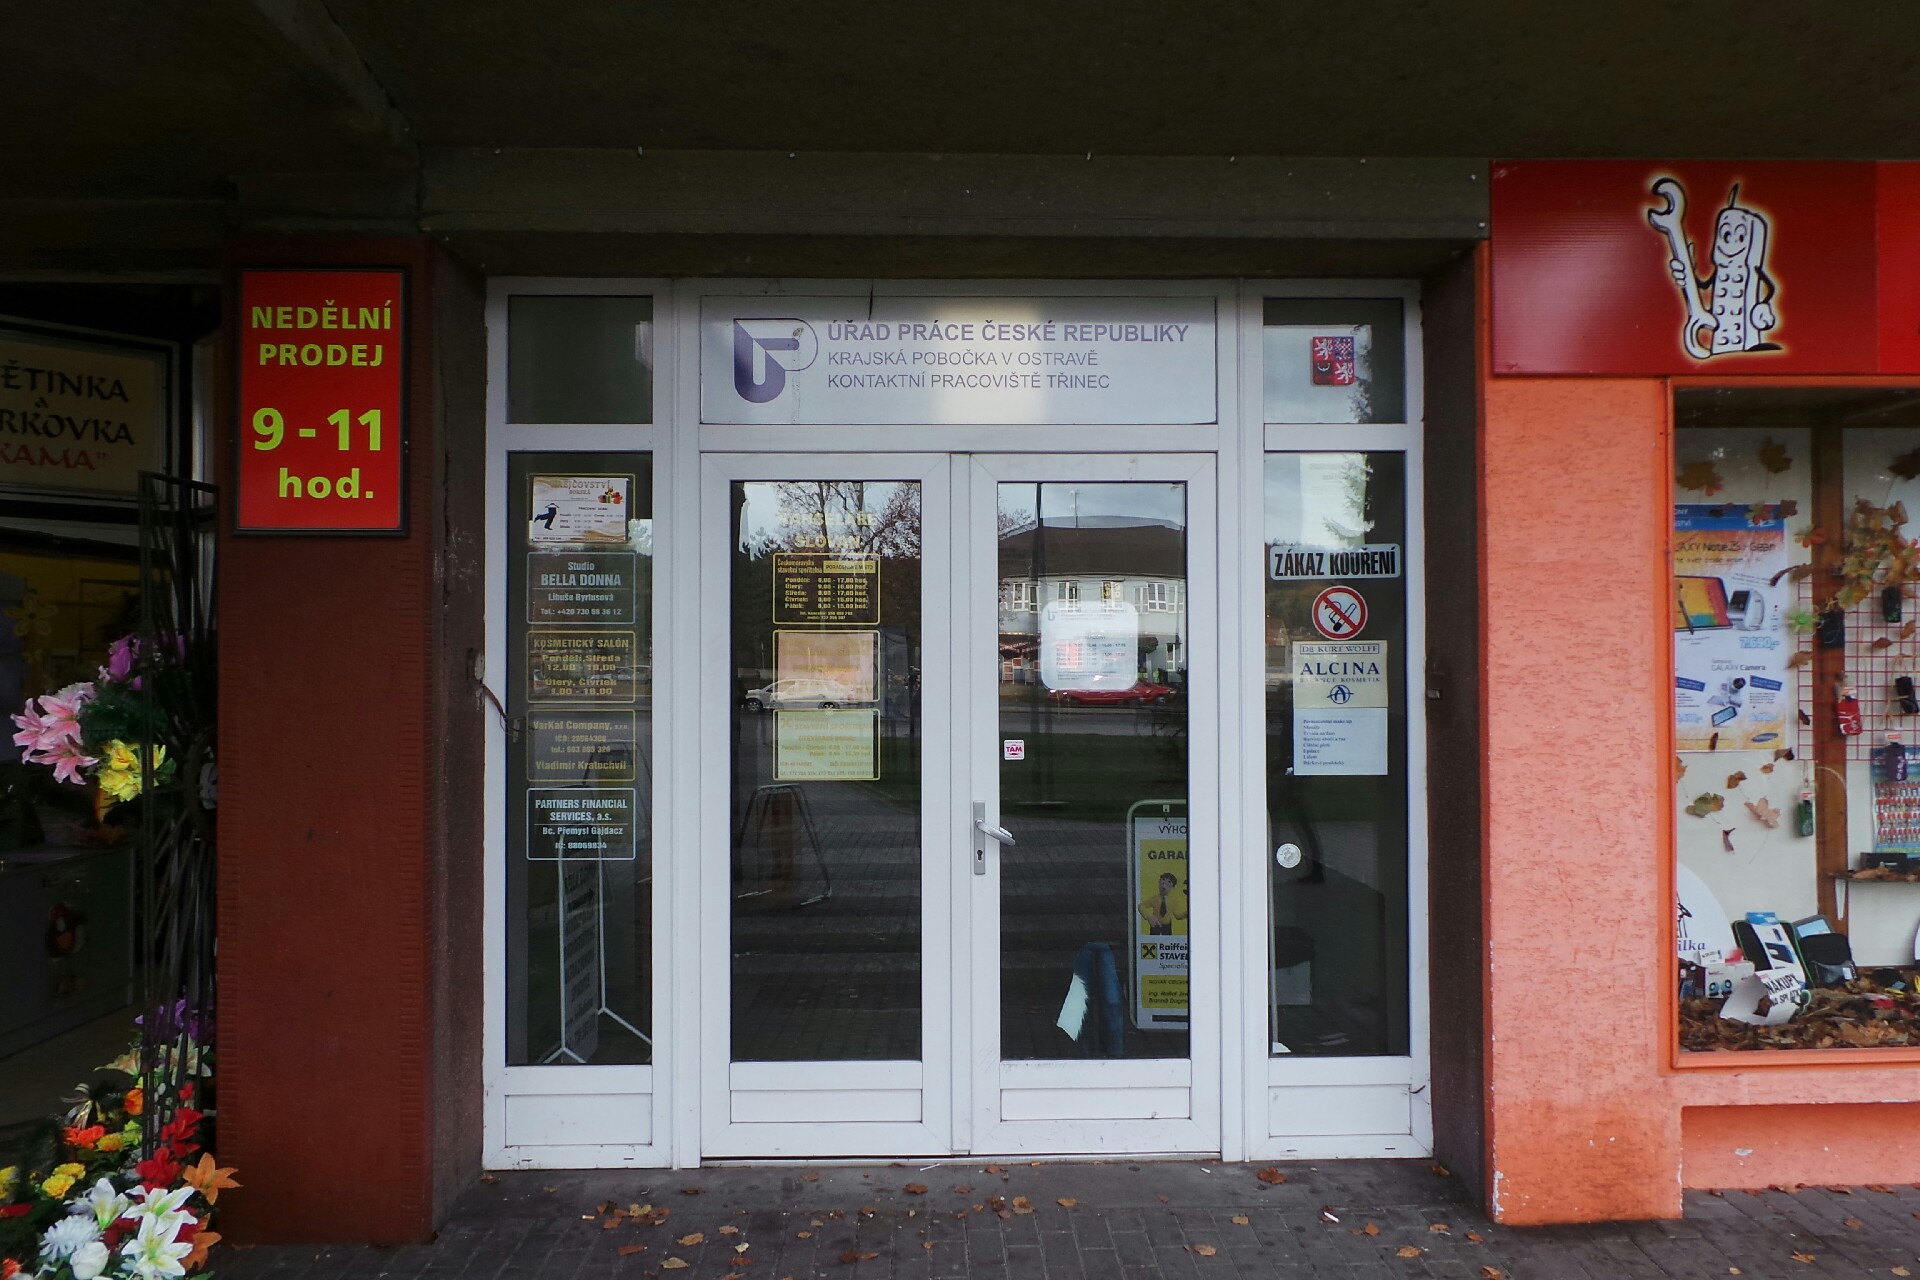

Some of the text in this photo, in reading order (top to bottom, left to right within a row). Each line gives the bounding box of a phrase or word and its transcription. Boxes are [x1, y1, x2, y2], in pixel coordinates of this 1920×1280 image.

[251, 300, 393, 330] NEDĚLNÍ
[828, 319, 1189, 343] ÚŘAD PRÁCE ČESKÉ REPUBLIKY
[259, 343, 384, 367] PRODEJ
[827, 349, 1099, 367] KRAJSKÁ POBOČKA V OSTRAVĚ
[827, 372, 1111, 390] KONTAKTNÍ PRACOVIŠTĚ TŘINEC
[251, 406, 382, 452] 9 - 11
[278, 467, 375, 499] hod.
[567, 561, 595, 571] Studio
[1274, 546, 1396, 577] ZÁKAZ KOUŘENÍ
[541, 573, 622, 586] BELLA DONNA
[533, 638, 629, 648] KOSMETICKÝ SALÓN
[1318, 645, 1343, 653] KURT
[1345, 645, 1378, 653] WOLFF
[1300, 662, 1380, 676] ALCINA
[535, 799, 629, 810] PARTNERS FINANCIAL
[550, 811, 613, 822] SERVICES, a.s.
[542, 827, 556, 836] Bc.
[1763, 973, 1801, 996] NÁKUPY
